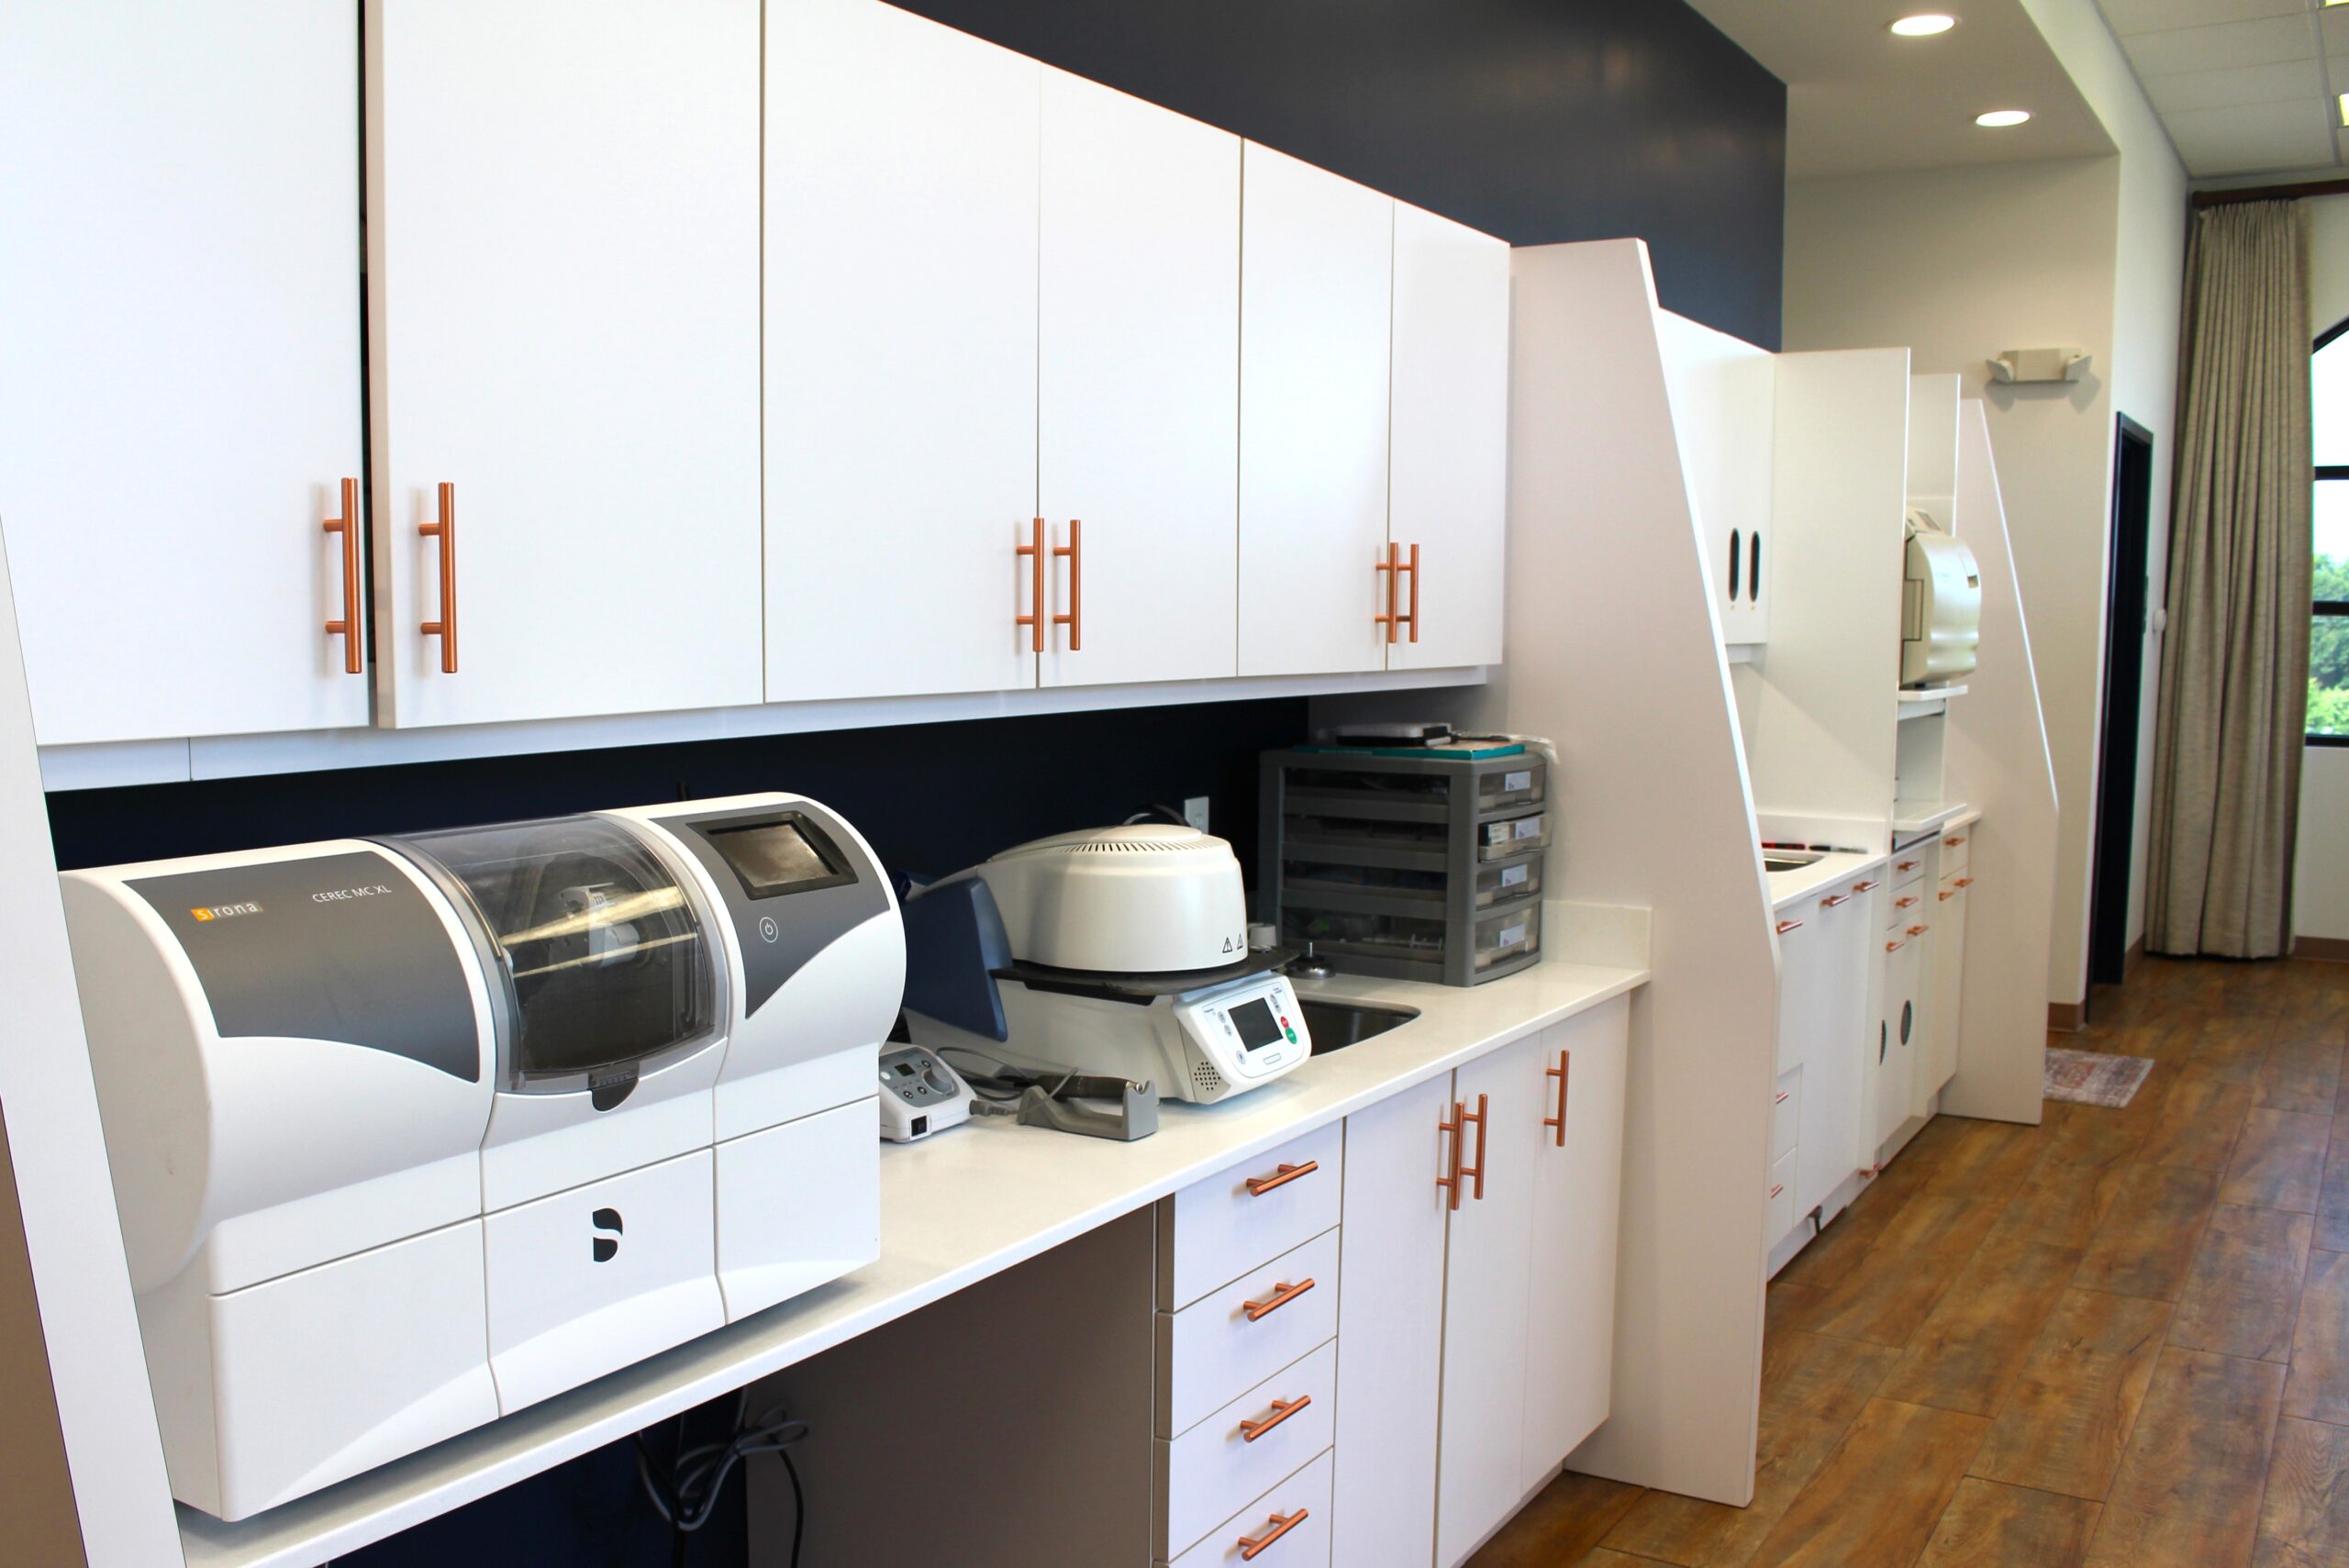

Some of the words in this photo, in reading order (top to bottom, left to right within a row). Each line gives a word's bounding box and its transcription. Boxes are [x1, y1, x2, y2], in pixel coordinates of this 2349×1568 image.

[312, 889, 353, 903] CEREC
[351, 886, 374, 897] MC
[372, 884, 393, 894] XL
